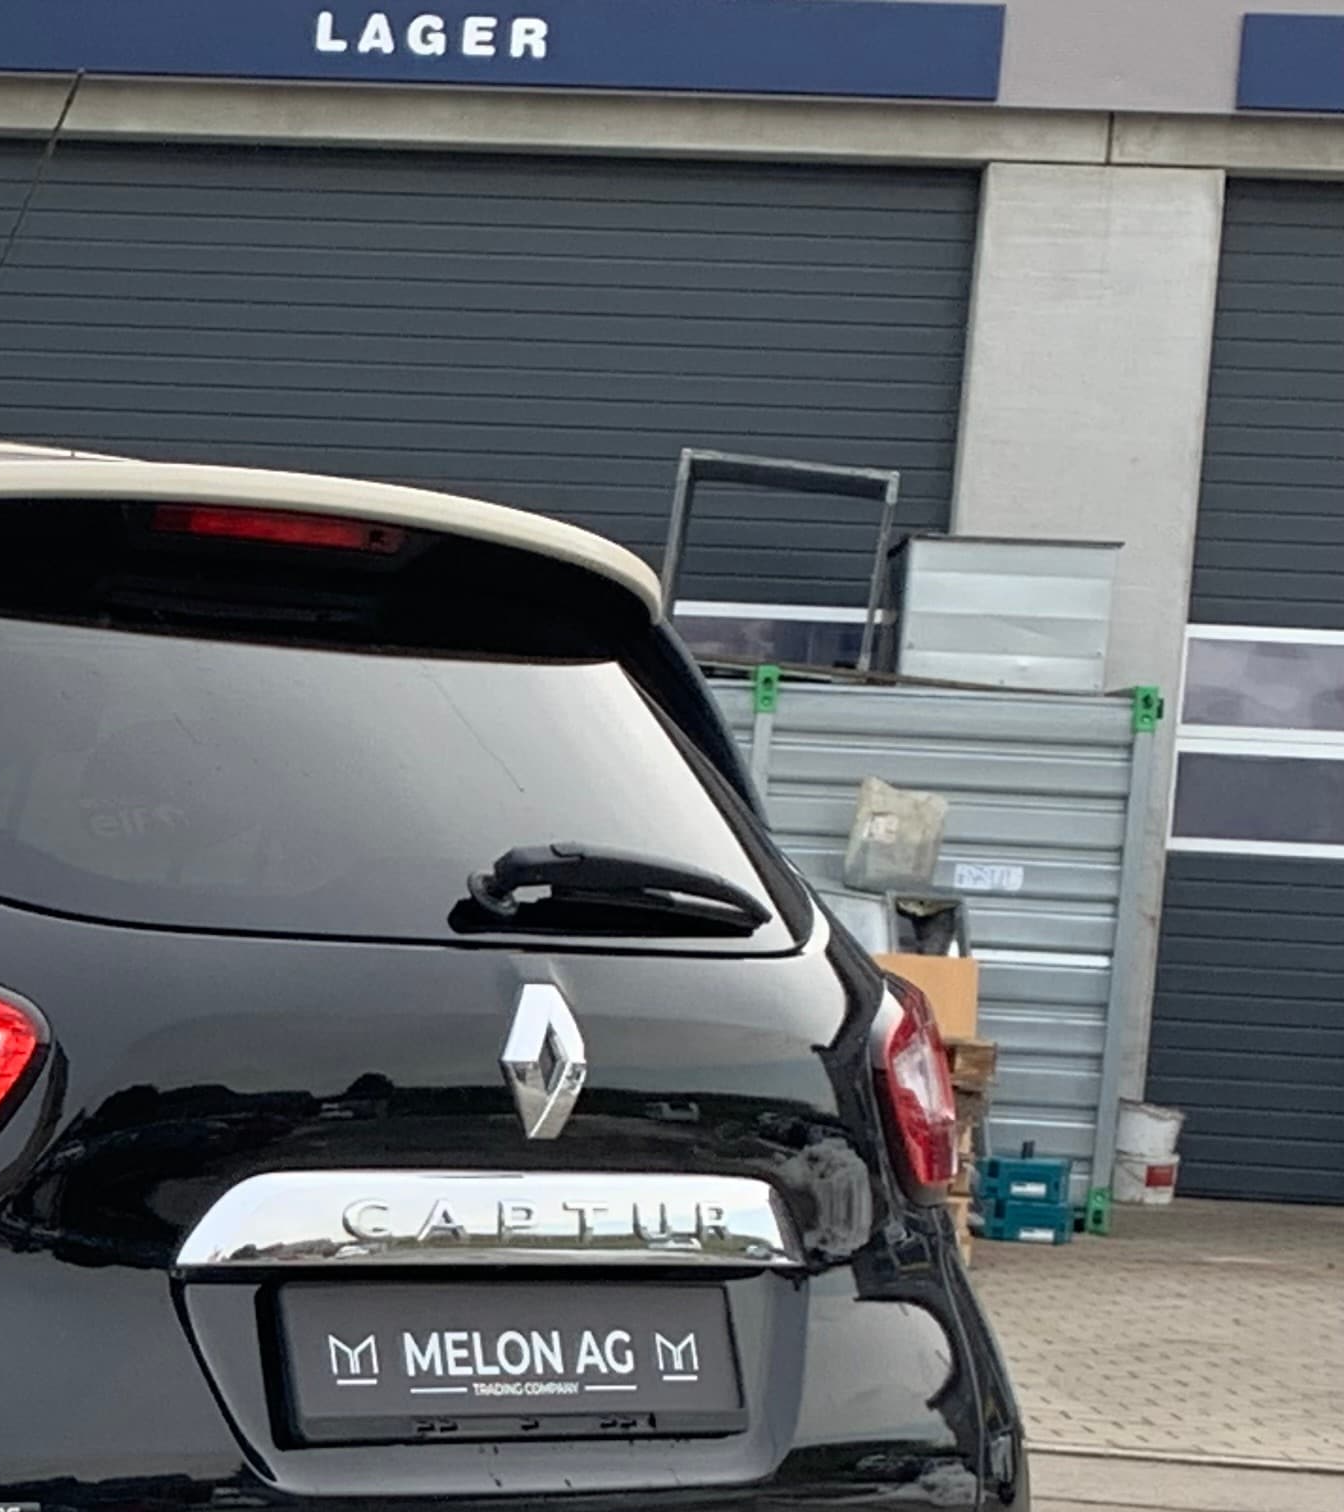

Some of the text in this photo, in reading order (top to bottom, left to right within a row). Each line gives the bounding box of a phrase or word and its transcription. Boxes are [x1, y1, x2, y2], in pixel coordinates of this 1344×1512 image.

[314, 10, 549, 58] LAGER
[341, 1198, 732, 1243] CAPTUR
[402, 1330, 564, 1376] MELON
[575, 1329, 635, 1375] AG
[472, 1381, 579, 1397] TRADING COMPANY
